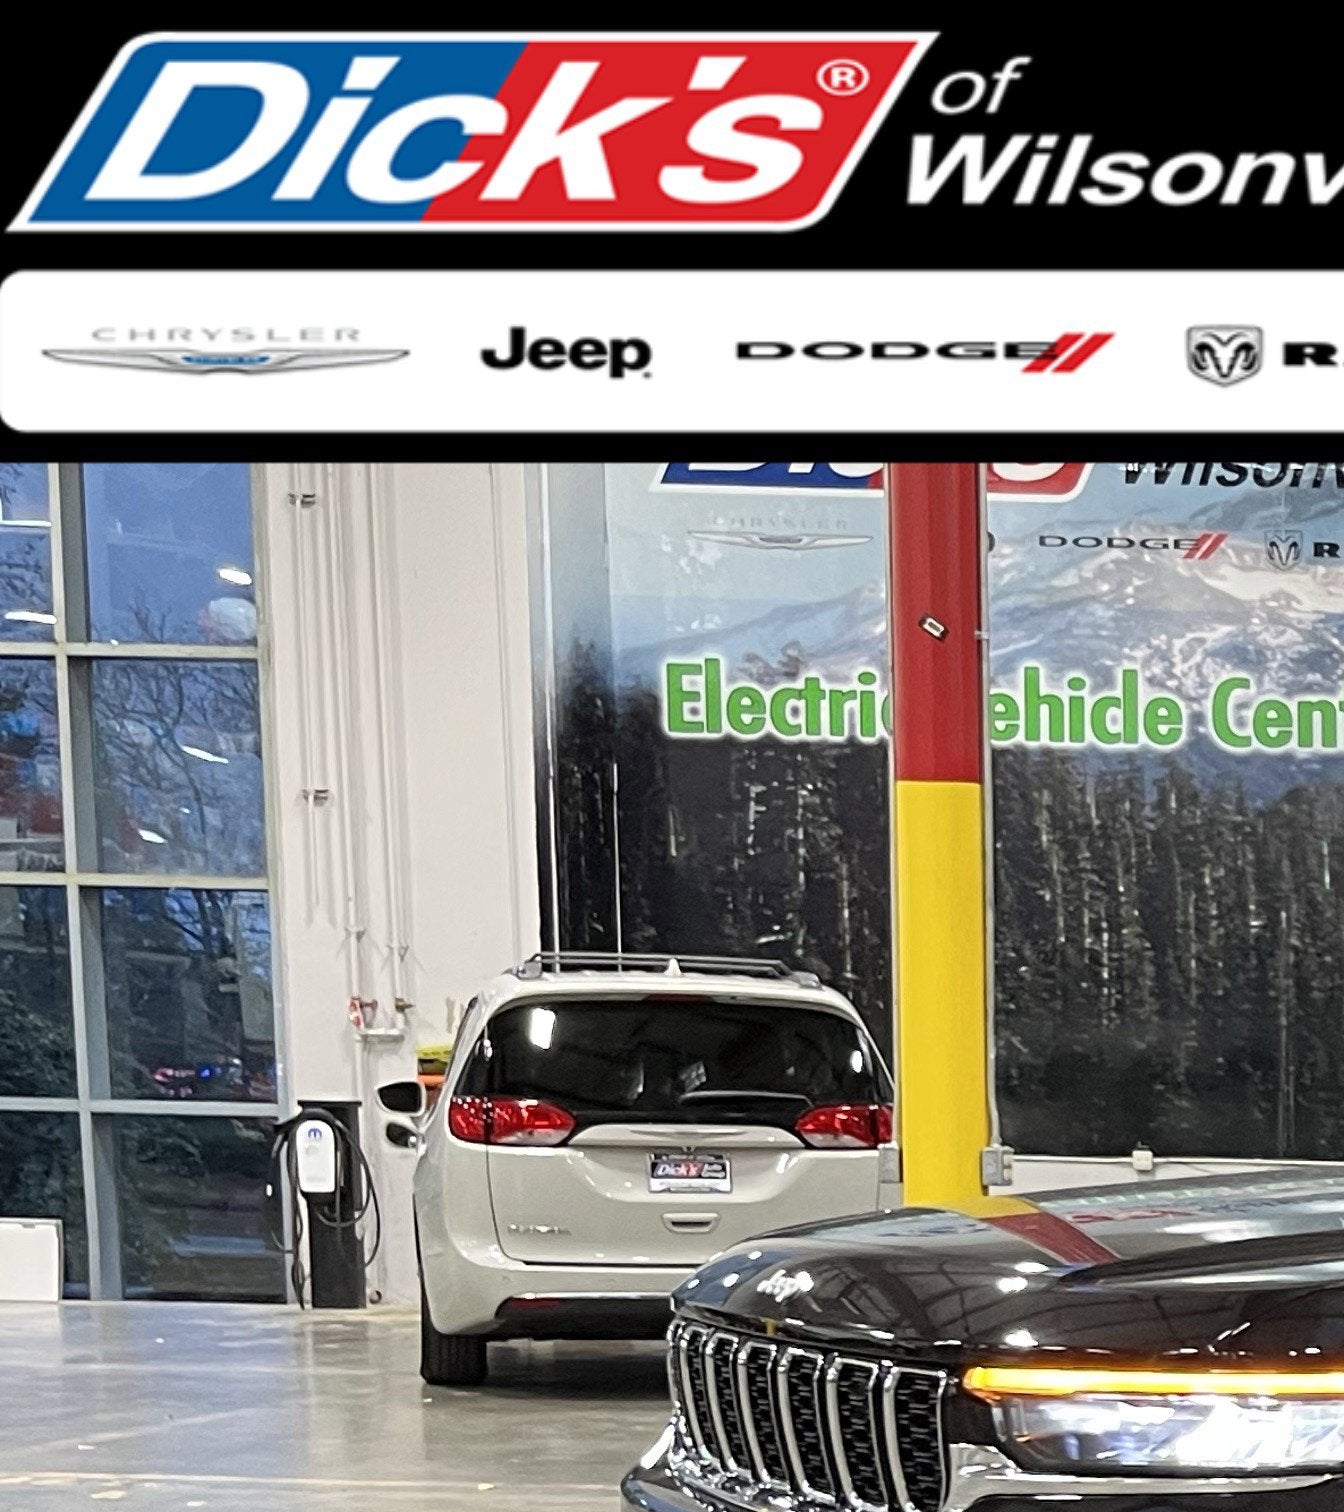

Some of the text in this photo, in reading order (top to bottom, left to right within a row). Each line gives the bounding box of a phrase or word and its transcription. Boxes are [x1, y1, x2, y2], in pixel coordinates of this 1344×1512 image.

[1039, 535, 1201, 552] DODGE
[665, 658, 890, 737] Electri
[989, 666, 1184, 746] ehicle
